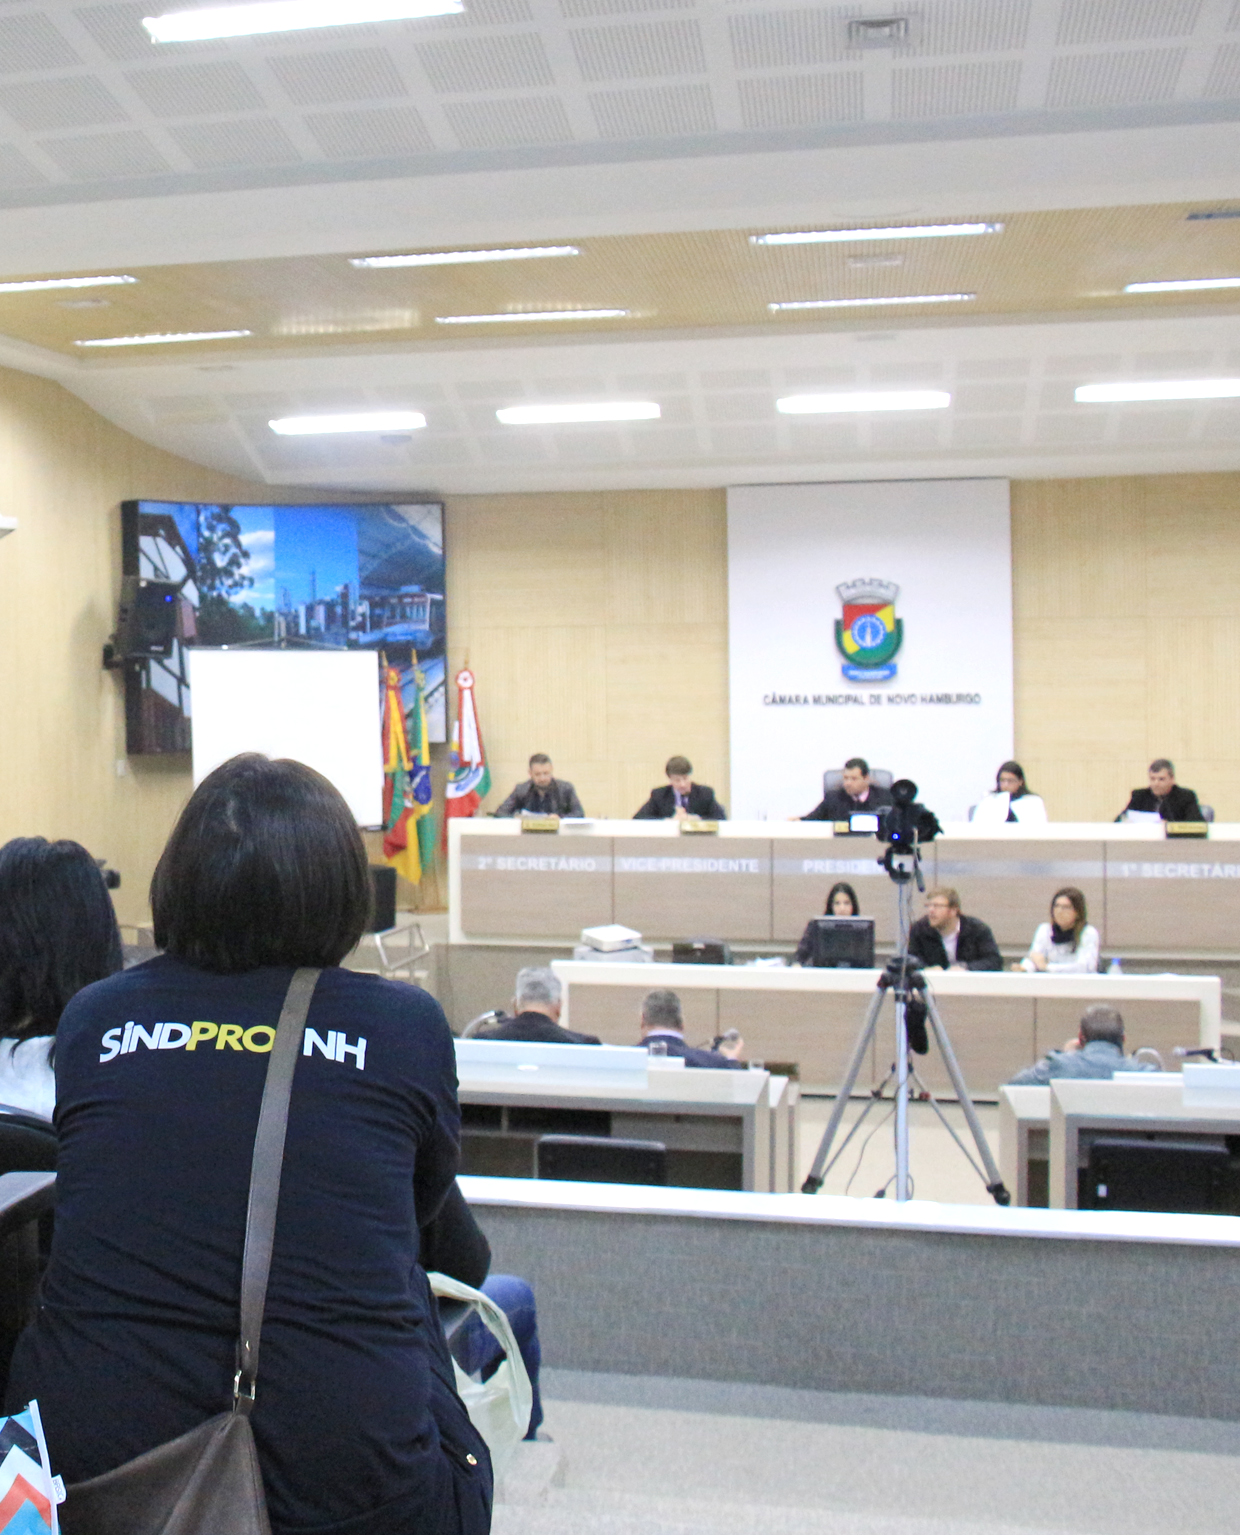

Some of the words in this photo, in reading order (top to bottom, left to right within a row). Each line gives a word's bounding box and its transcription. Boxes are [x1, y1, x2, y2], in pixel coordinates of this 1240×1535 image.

[763, 691, 809, 706] CÂMARA
[812, 693, 866, 706] MUNICIPAL
[869, 693, 883, 706] DE
[887, 693, 918, 705] NOVO
[920, 693, 982, 705] HAMBURGO
[496, 855, 597, 872] SECRETÁRIO
[621, 857, 759, 873] VICE-PRESIDENTE
